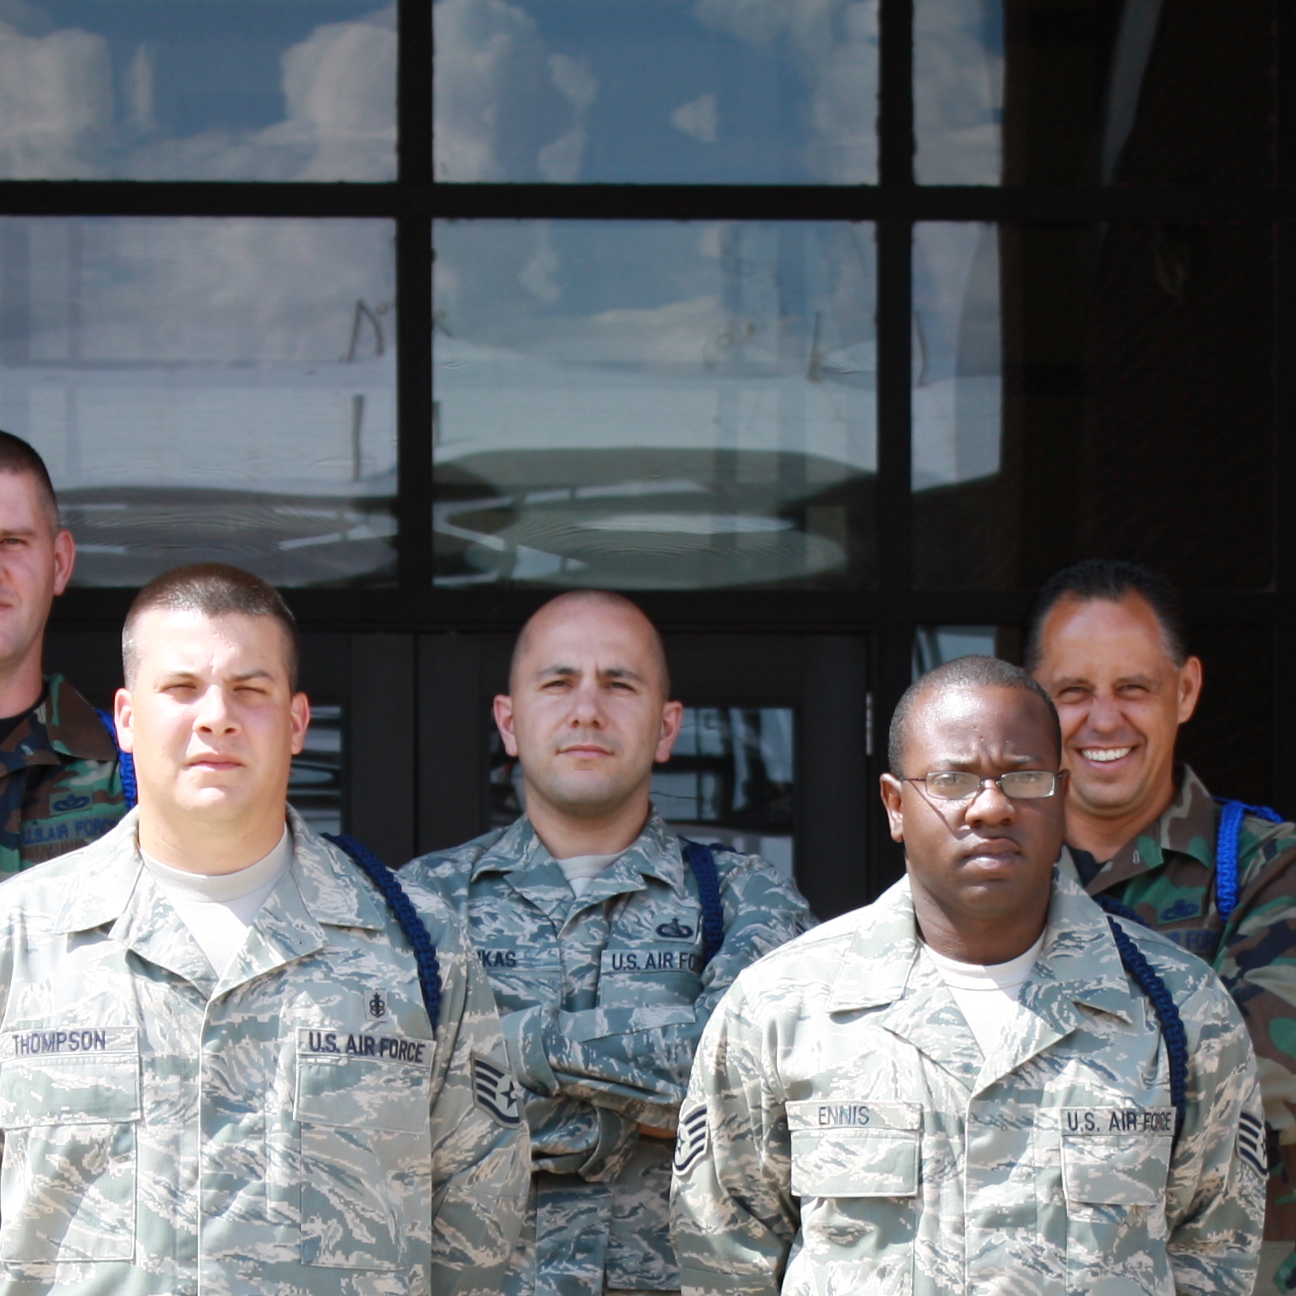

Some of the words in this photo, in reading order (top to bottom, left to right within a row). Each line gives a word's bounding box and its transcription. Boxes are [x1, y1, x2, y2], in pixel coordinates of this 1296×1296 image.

[75, 818, 119, 837] FORC
[612, 953, 641, 971] U.S.
[646, 952, 674, 970] AIR
[679, 953, 697, 971] FO
[12, 1029, 106, 1056] THOMPSON
[308, 1031, 341, 1054] U.S.
[345, 1034, 376, 1057] AIR
[379, 1037, 426, 1063] FORCE
[818, 1106, 870, 1126] ENNIS
[1067, 1110, 1100, 1133] U.S.
[1108, 1110, 1137, 1132] AIR
[1142, 1110, 1172, 1132] FORCE
